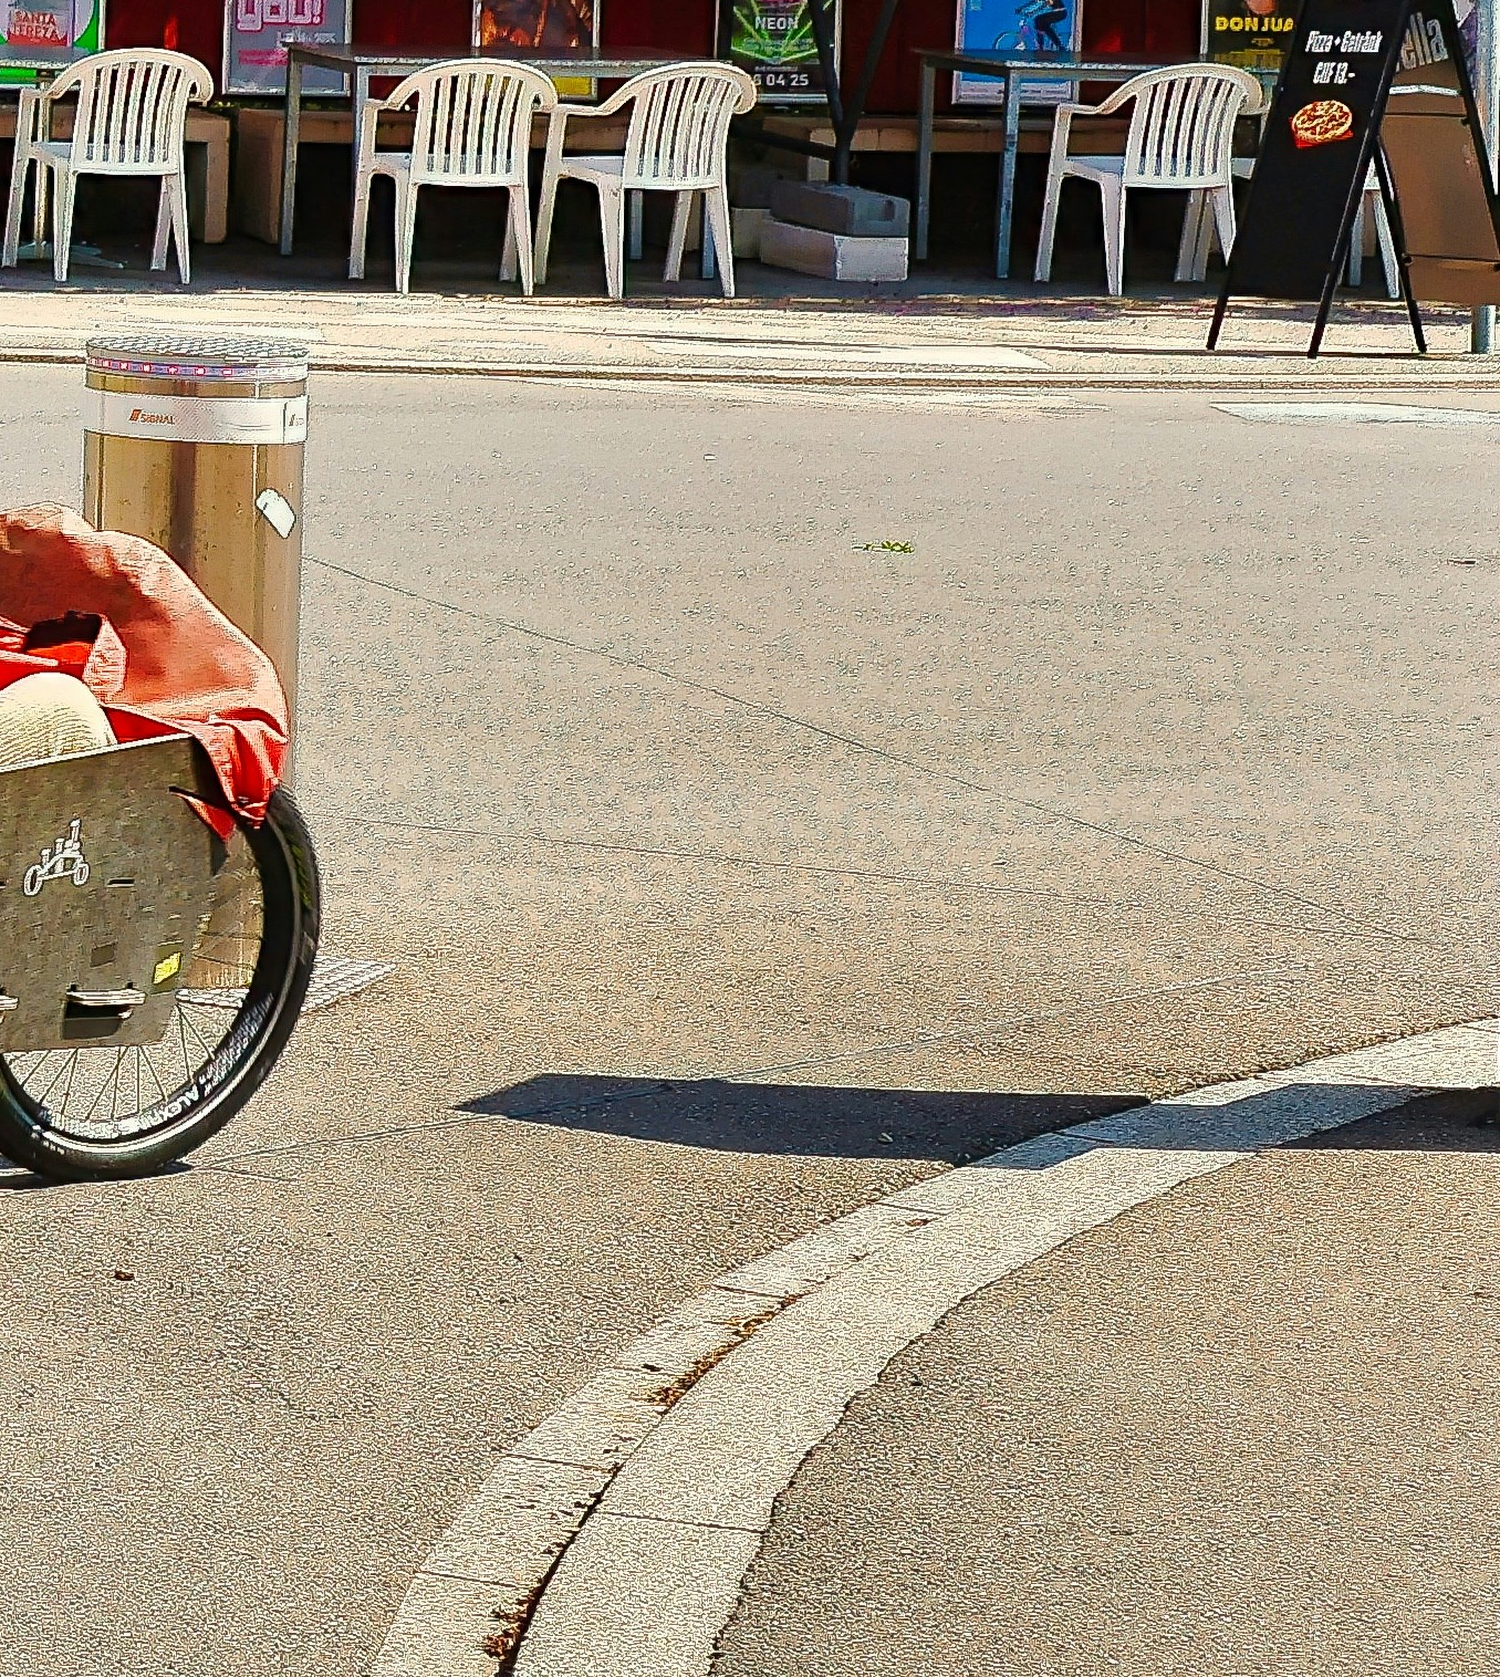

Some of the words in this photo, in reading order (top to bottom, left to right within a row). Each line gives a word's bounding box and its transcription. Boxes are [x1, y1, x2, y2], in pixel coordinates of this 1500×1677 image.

[15, 10, 57, 26] SANTA
[755, 16, 799, 30] NEON
[1215, 15, 1258, 32] DON
[1305, 30, 1331, 52] Pizza
[766, 74, 786, 86] 04
[790, 74, 809, 86] 25
[1313, 62, 1336, 84] CHF
